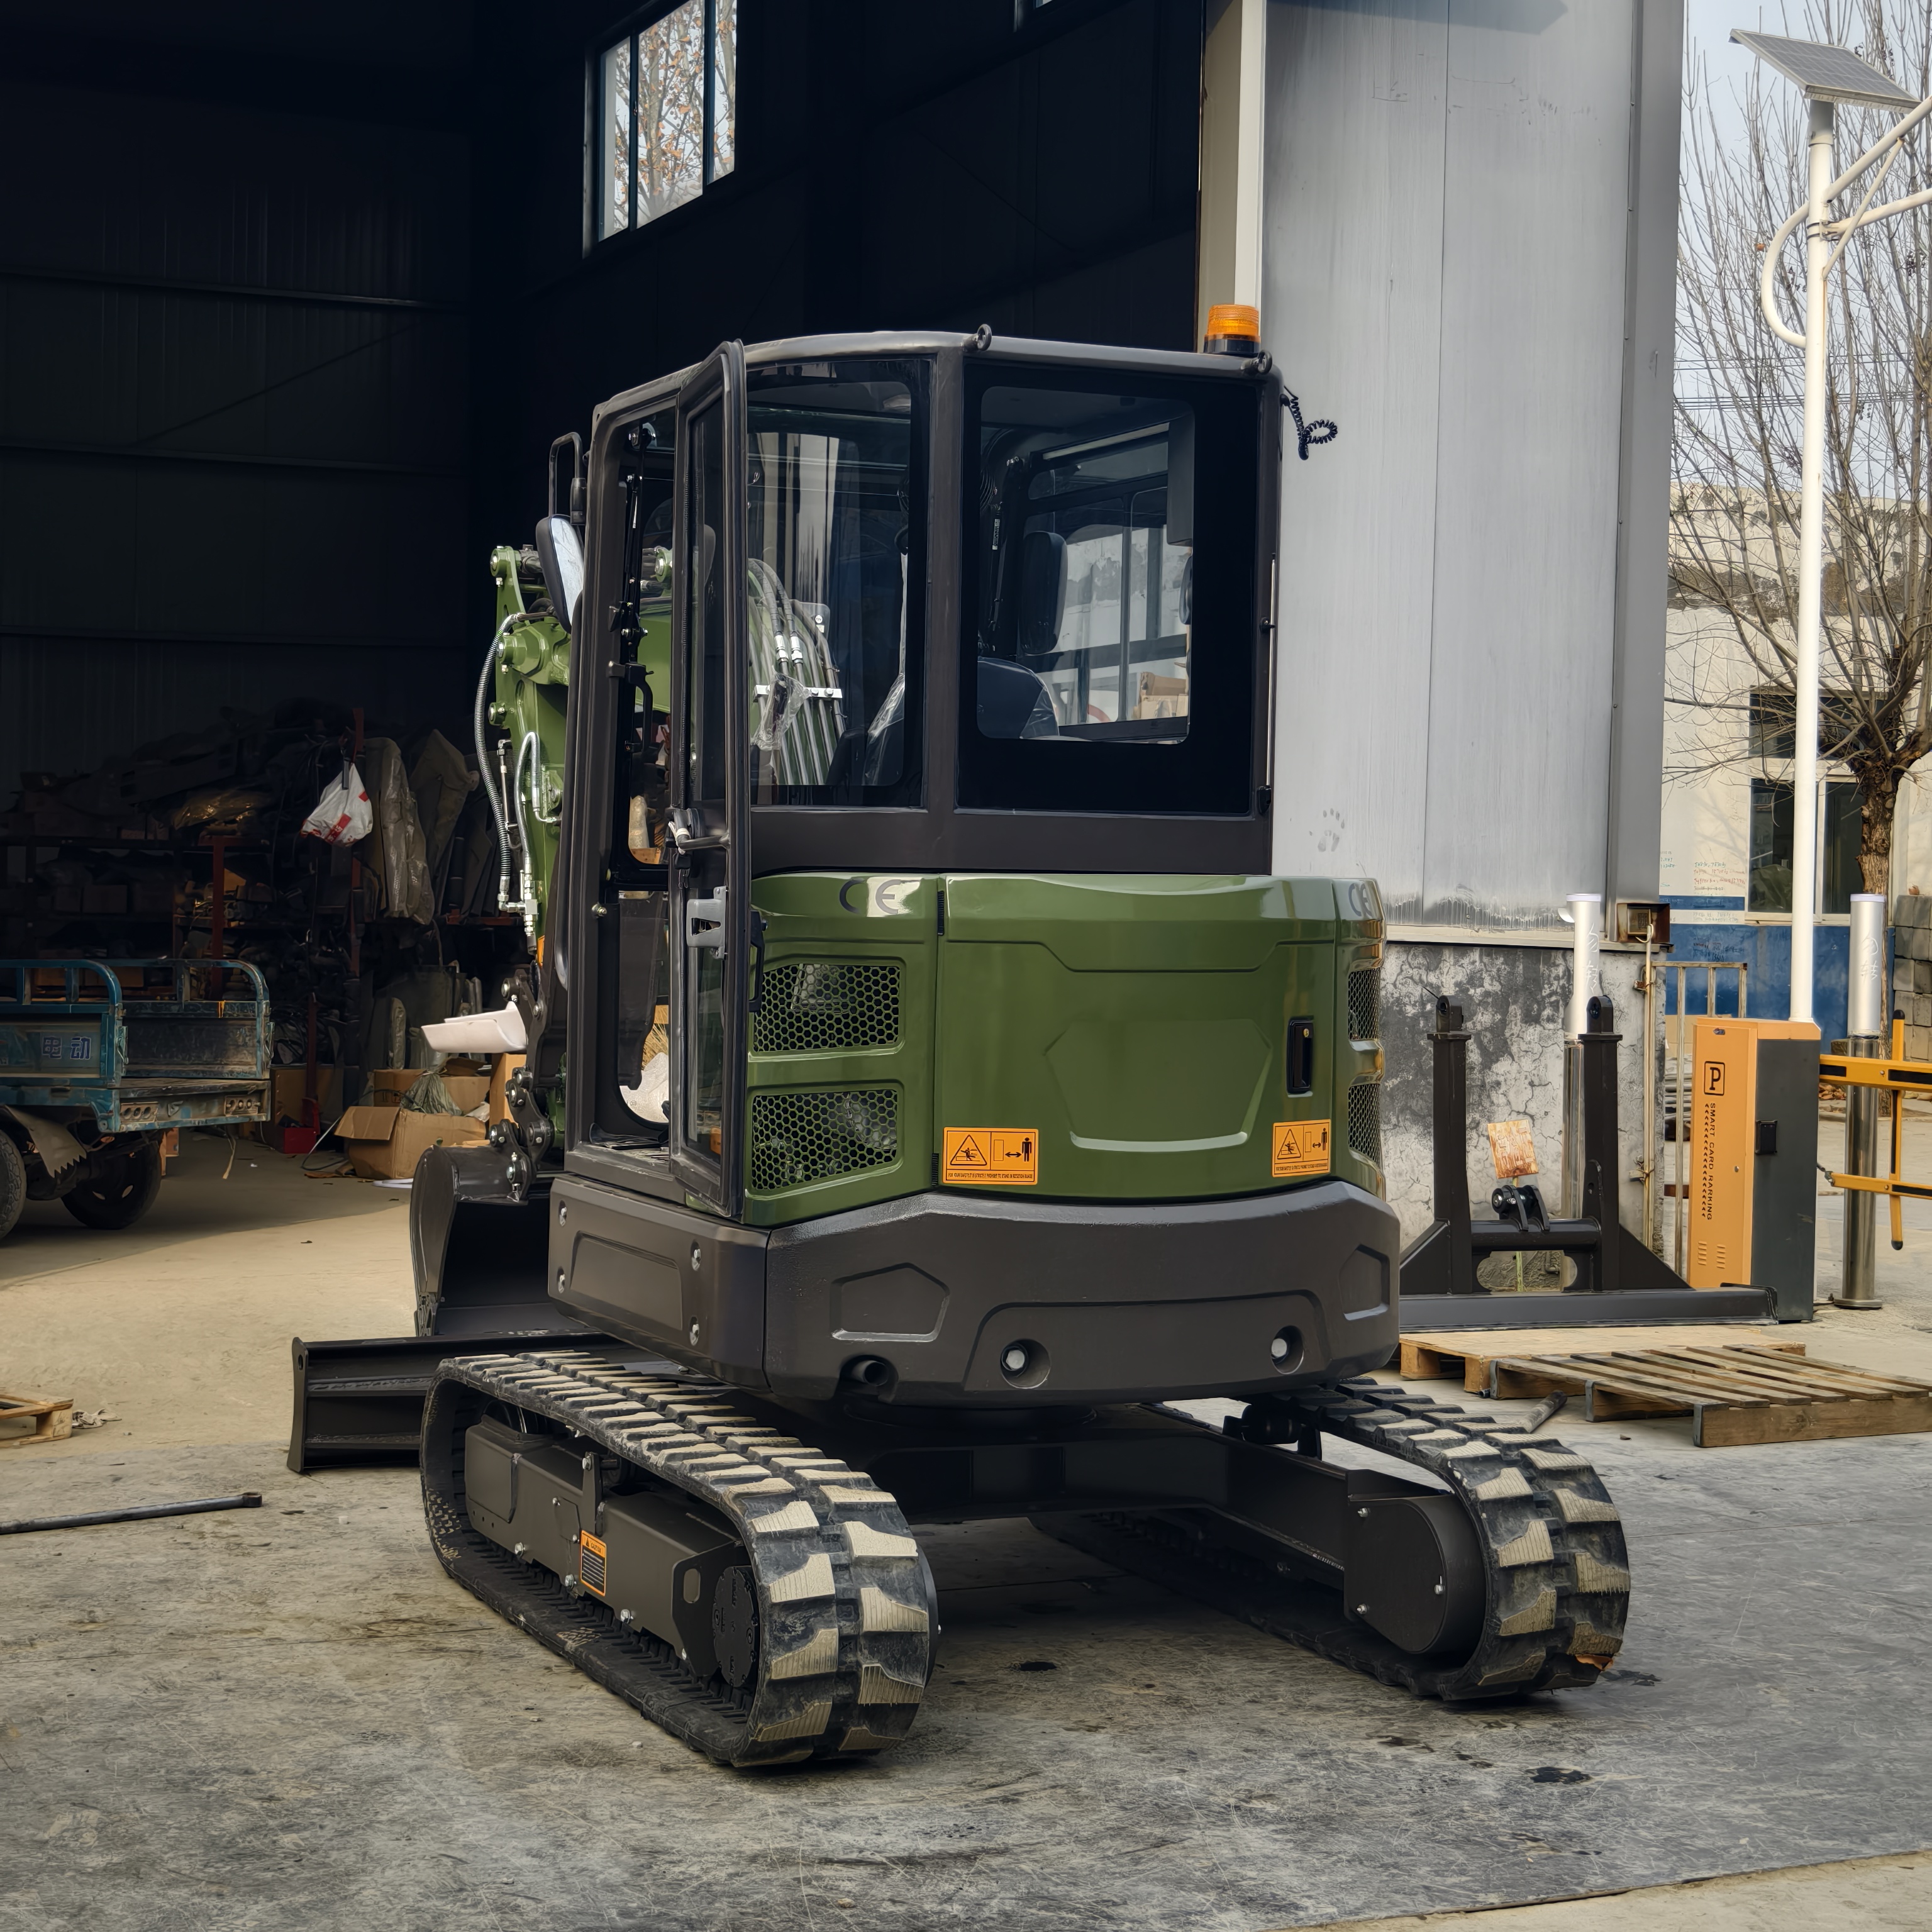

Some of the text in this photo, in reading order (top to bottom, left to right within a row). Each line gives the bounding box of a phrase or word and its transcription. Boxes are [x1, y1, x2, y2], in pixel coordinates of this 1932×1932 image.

[839, 878, 915, 914] CE
[42, 1036, 91, 1060] 电动
[1709, 1067, 1721, 1091] P
[591, 1542, 602, 1553] CAUTION
